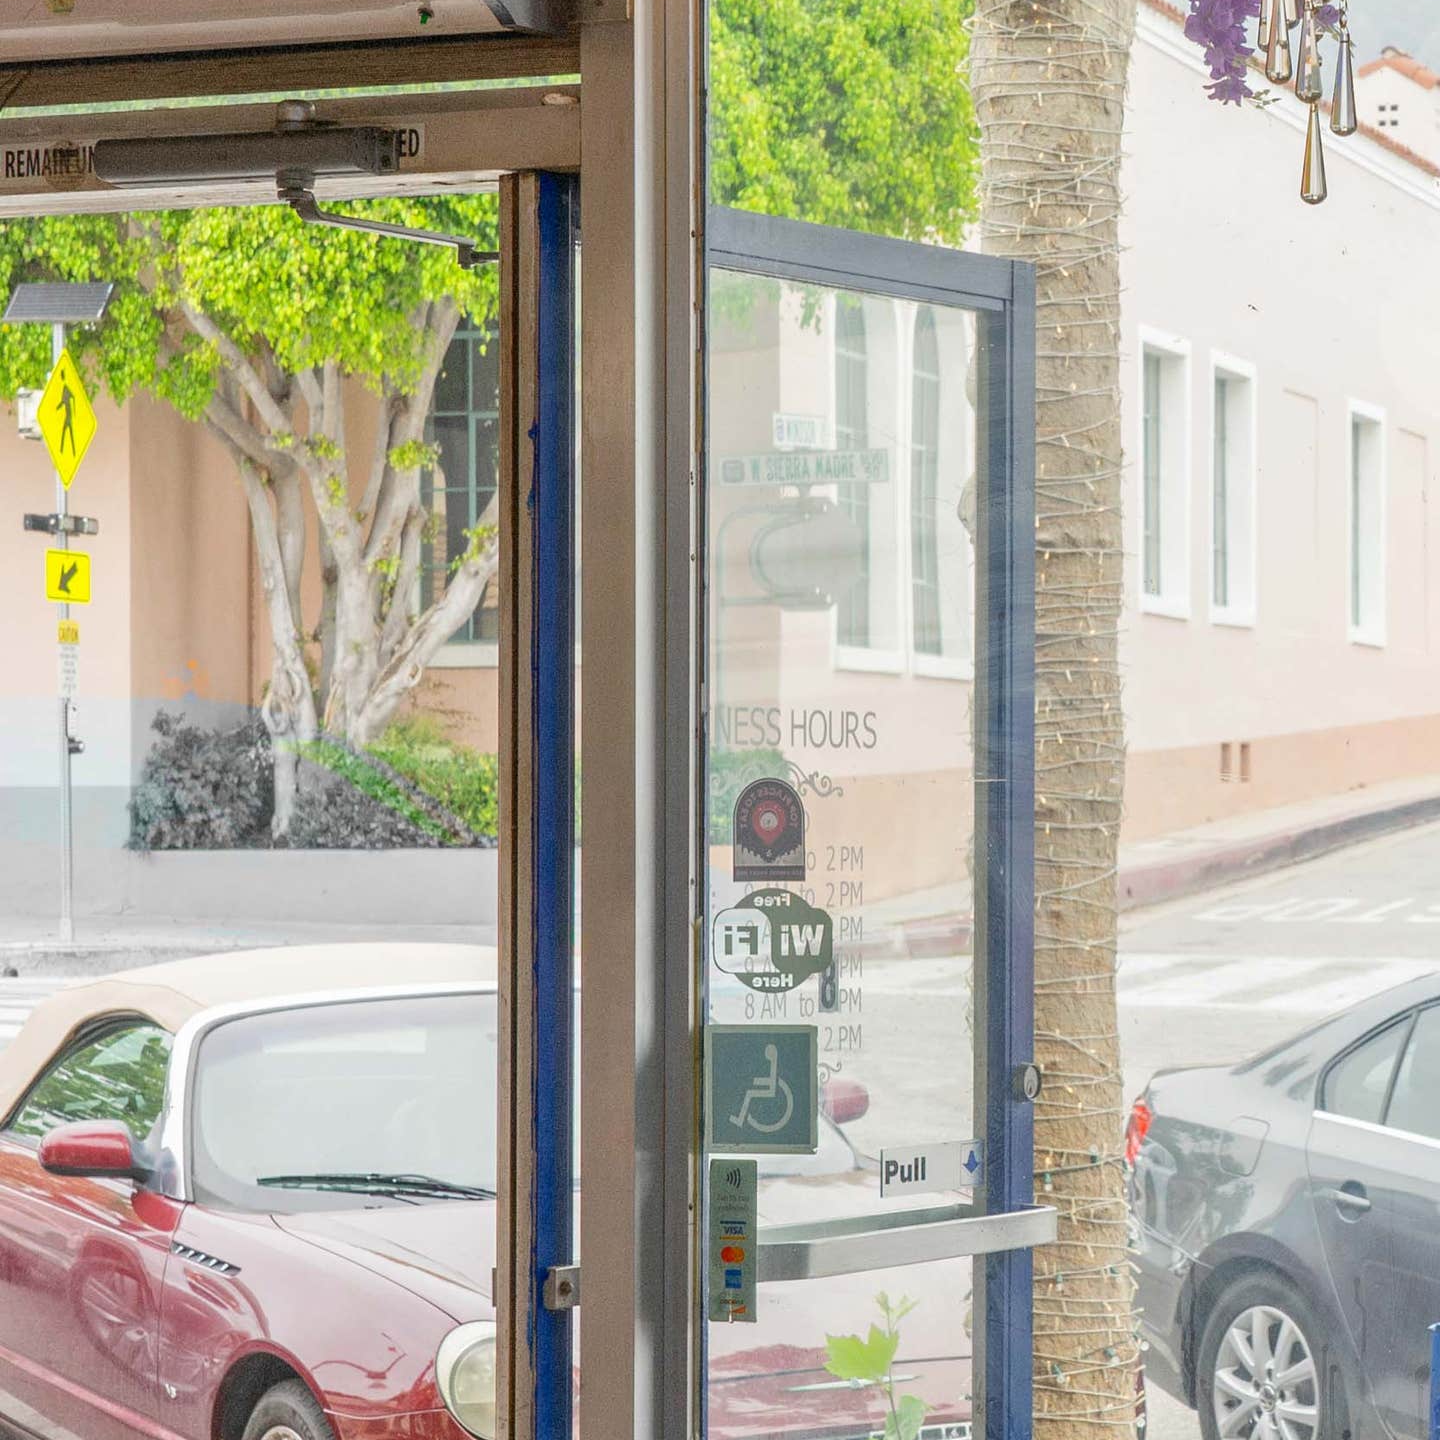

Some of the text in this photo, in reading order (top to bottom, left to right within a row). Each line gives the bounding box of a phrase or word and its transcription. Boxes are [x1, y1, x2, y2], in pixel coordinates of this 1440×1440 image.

[766, 455, 809, 481] SIERRA
[815, 453, 857, 479] MADRE
[790, 709, 877, 749] HOURS
[840, 846, 863, 871] PM
[840, 880, 863, 907] PM
[840, 916, 863, 941] PM
[761, 993, 786, 1020] AM
[800, 993, 815, 1018] to
[840, 988, 862, 1012] PM
[839, 1024, 862, 1050] PM
[885, 1156, 926, 1185] Pull
[724, 1226, 743, 1235] VISA
